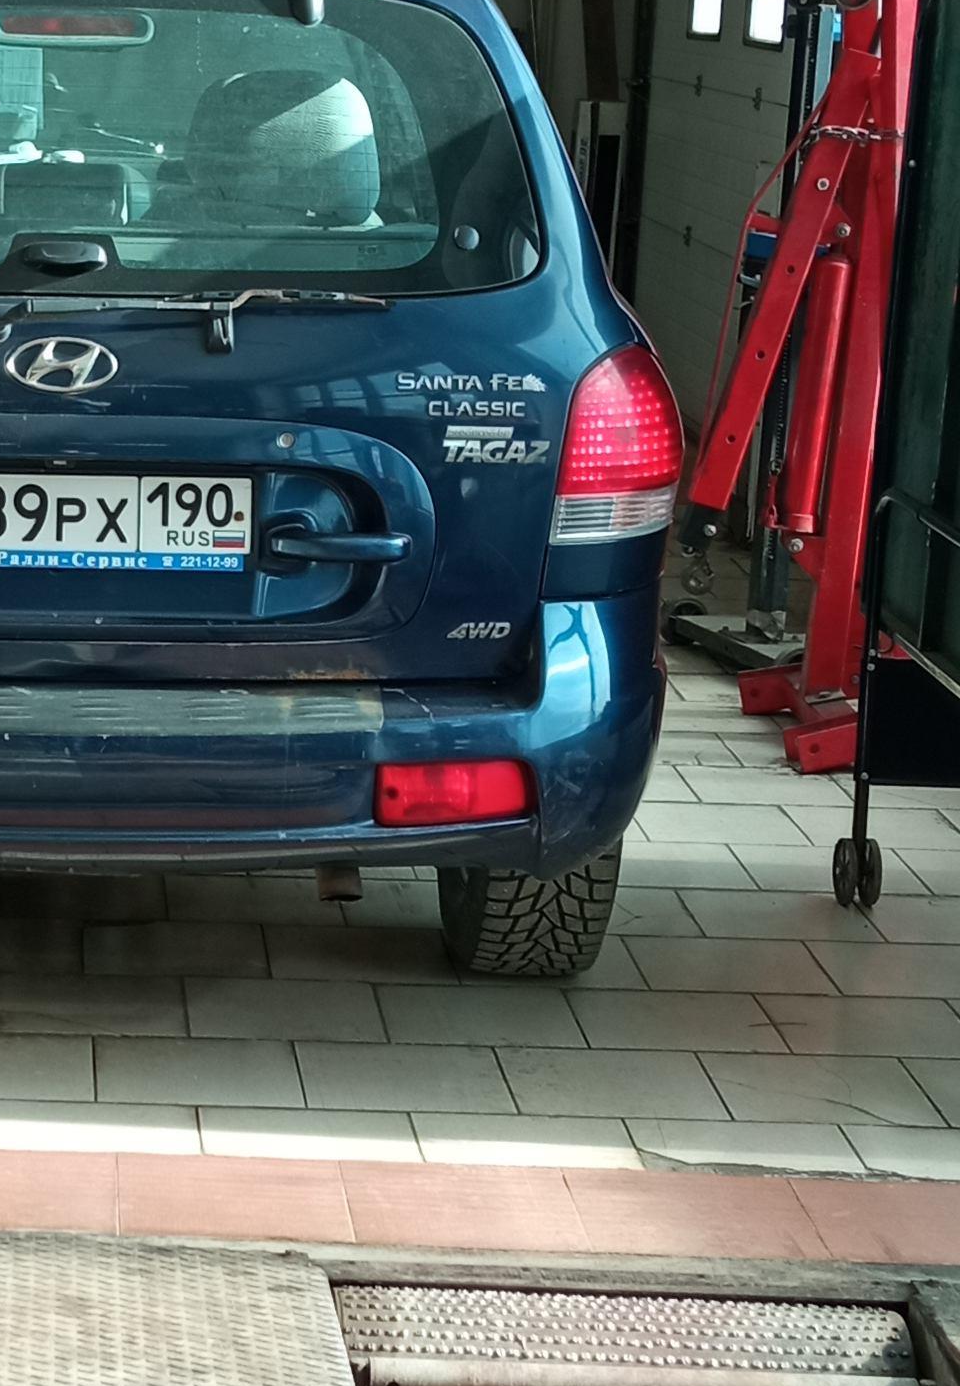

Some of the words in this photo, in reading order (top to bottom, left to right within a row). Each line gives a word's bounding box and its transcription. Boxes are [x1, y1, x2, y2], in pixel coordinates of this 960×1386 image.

[397, 372, 484, 392] SANTA
[428, 400, 526, 417] CLASSIC
[442, 439, 551, 464] TAGAZ
[147, 482, 233, 527] 190
[166, 530, 210, 547] RUS
[180, 556, 239, 568] 221-12-99
[446, 621, 511, 640] 4WD
